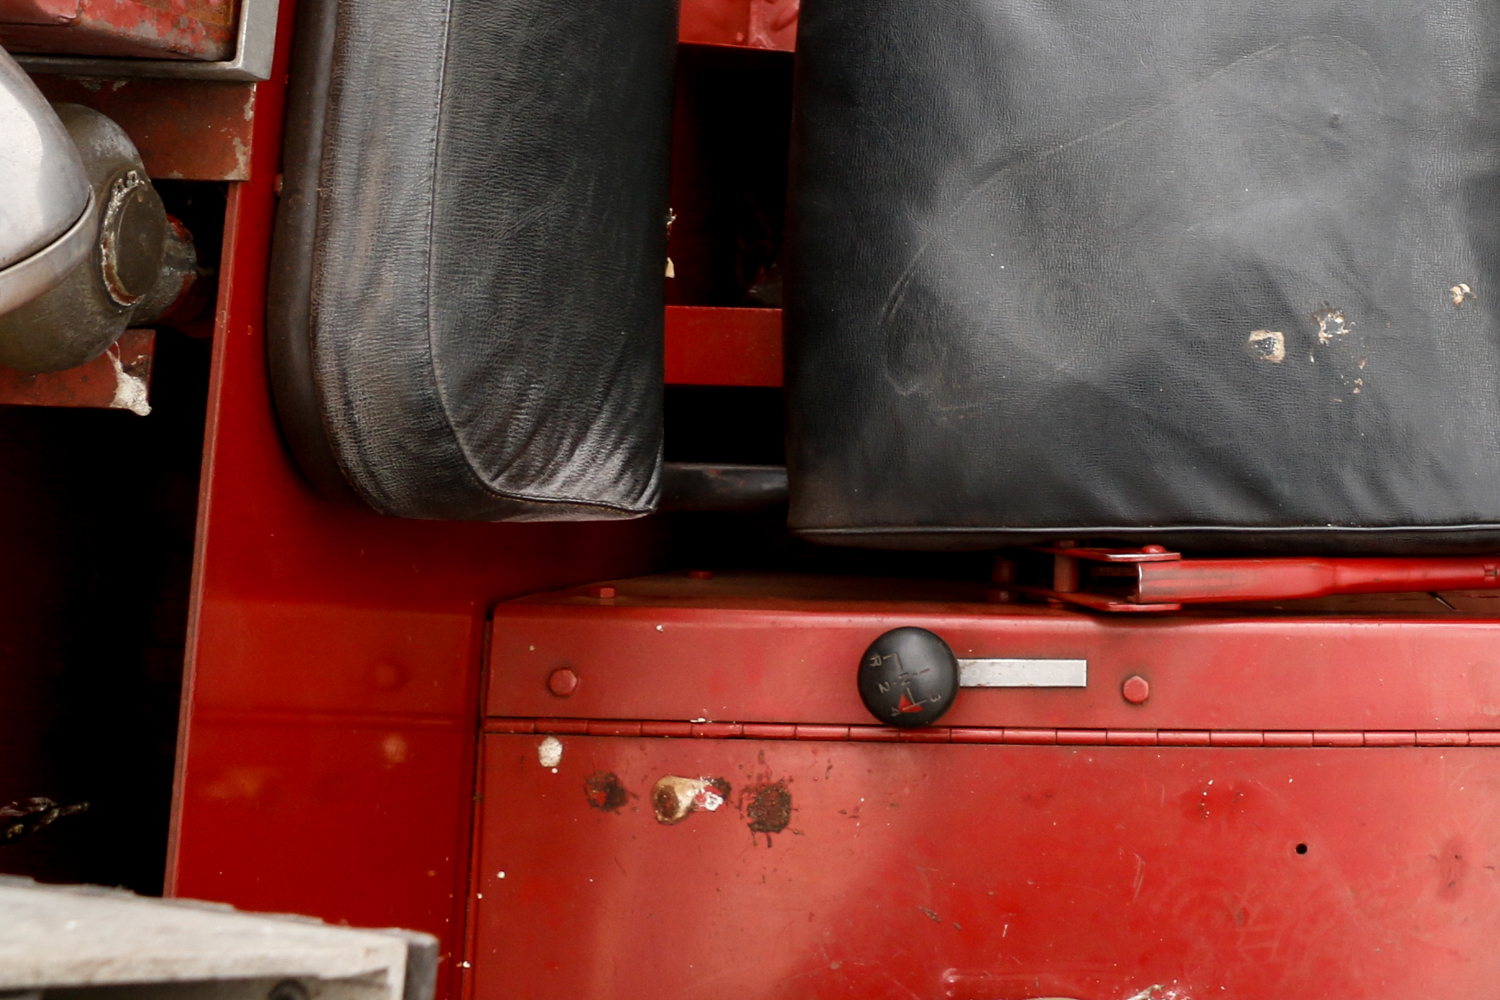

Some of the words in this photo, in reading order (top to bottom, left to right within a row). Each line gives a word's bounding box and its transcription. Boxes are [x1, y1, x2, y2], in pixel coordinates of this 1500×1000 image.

[870, 654, 882, 666] R
[878, 682, 890, 694] 2
[930, 693, 941, 703] 3
[890, 706, 901, 717] 4
